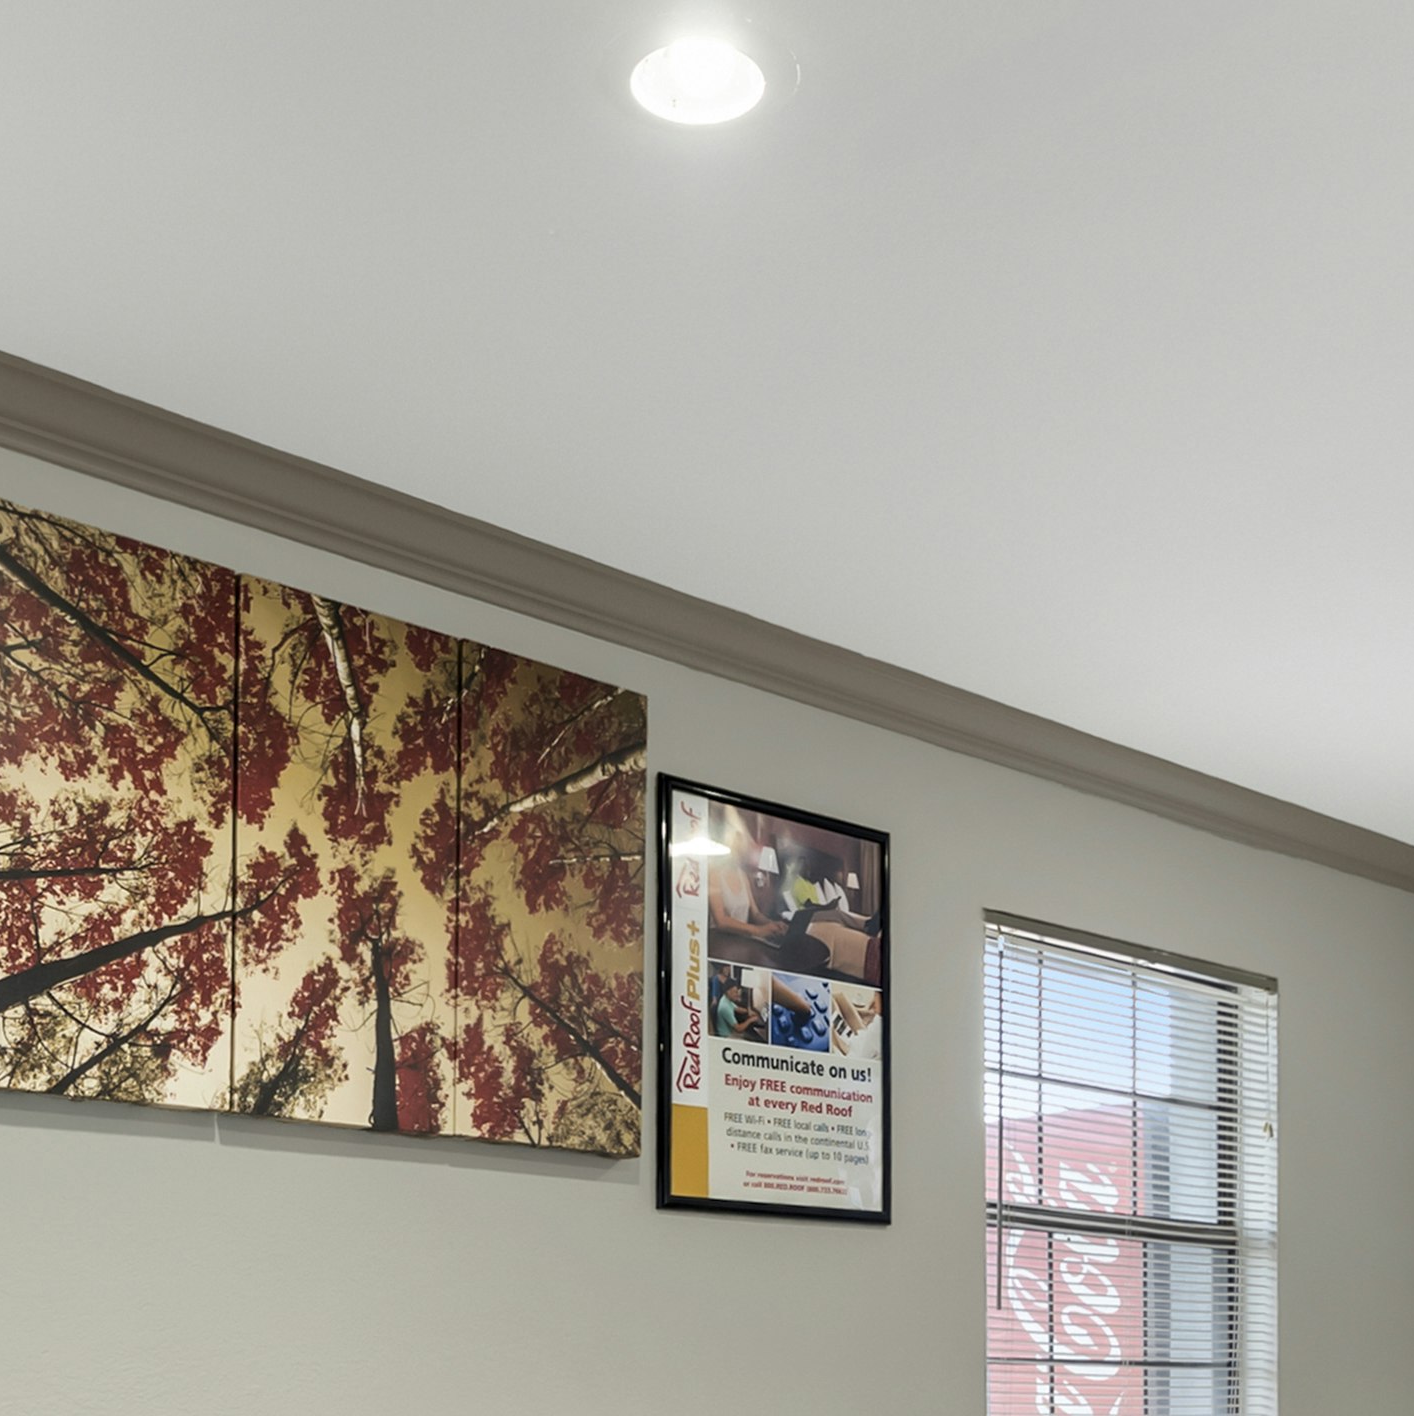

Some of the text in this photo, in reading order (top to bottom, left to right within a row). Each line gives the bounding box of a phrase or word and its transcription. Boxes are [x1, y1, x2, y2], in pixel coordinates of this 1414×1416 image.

[722, 1047, 871, 1082] Communicate on us!
[725, 1074, 873, 1103] Enjoy FREE communication
[748, 1096, 852, 1117] at every Red Roof
[724, 1112, 742, 1123] FREE
[773, 1118, 791, 1128] FREE
[794, 1120, 811, 1130] local
[813, 1123, 828, 1133] calls
[837, 1125, 853, 1135] FREE
[726, 1127, 855, 1149] distance calls in the continental
[738, 1142, 868, 1165] FREE fax service (up to 10 pages)
